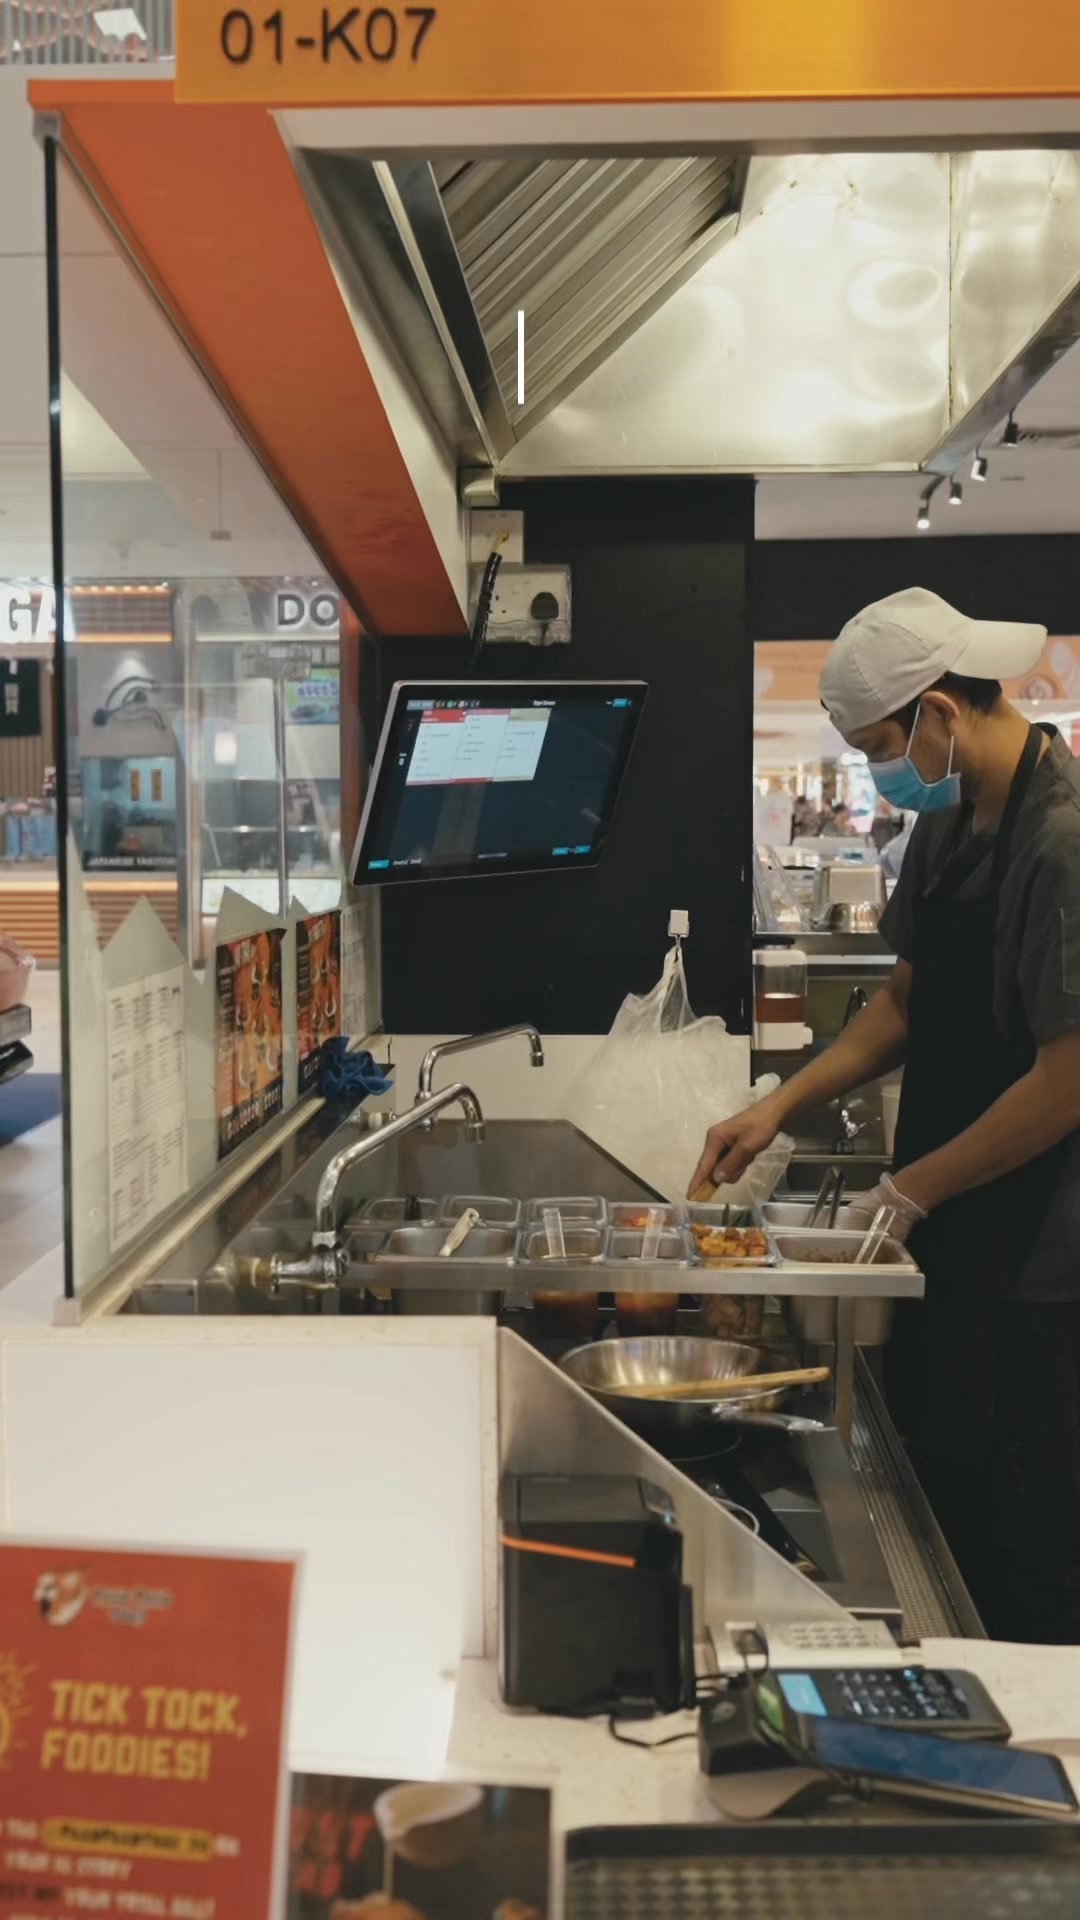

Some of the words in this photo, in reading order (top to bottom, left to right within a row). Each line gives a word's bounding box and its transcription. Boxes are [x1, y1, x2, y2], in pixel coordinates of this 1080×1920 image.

[221, 8, 437, 65] 01-K07
[277, 594, 340, 626] DO
[50, 1679, 132, 1725] TICK
[141, 1685, 248, 1740] TOCK,
[40, 1727, 212, 1783] FOODIES!
